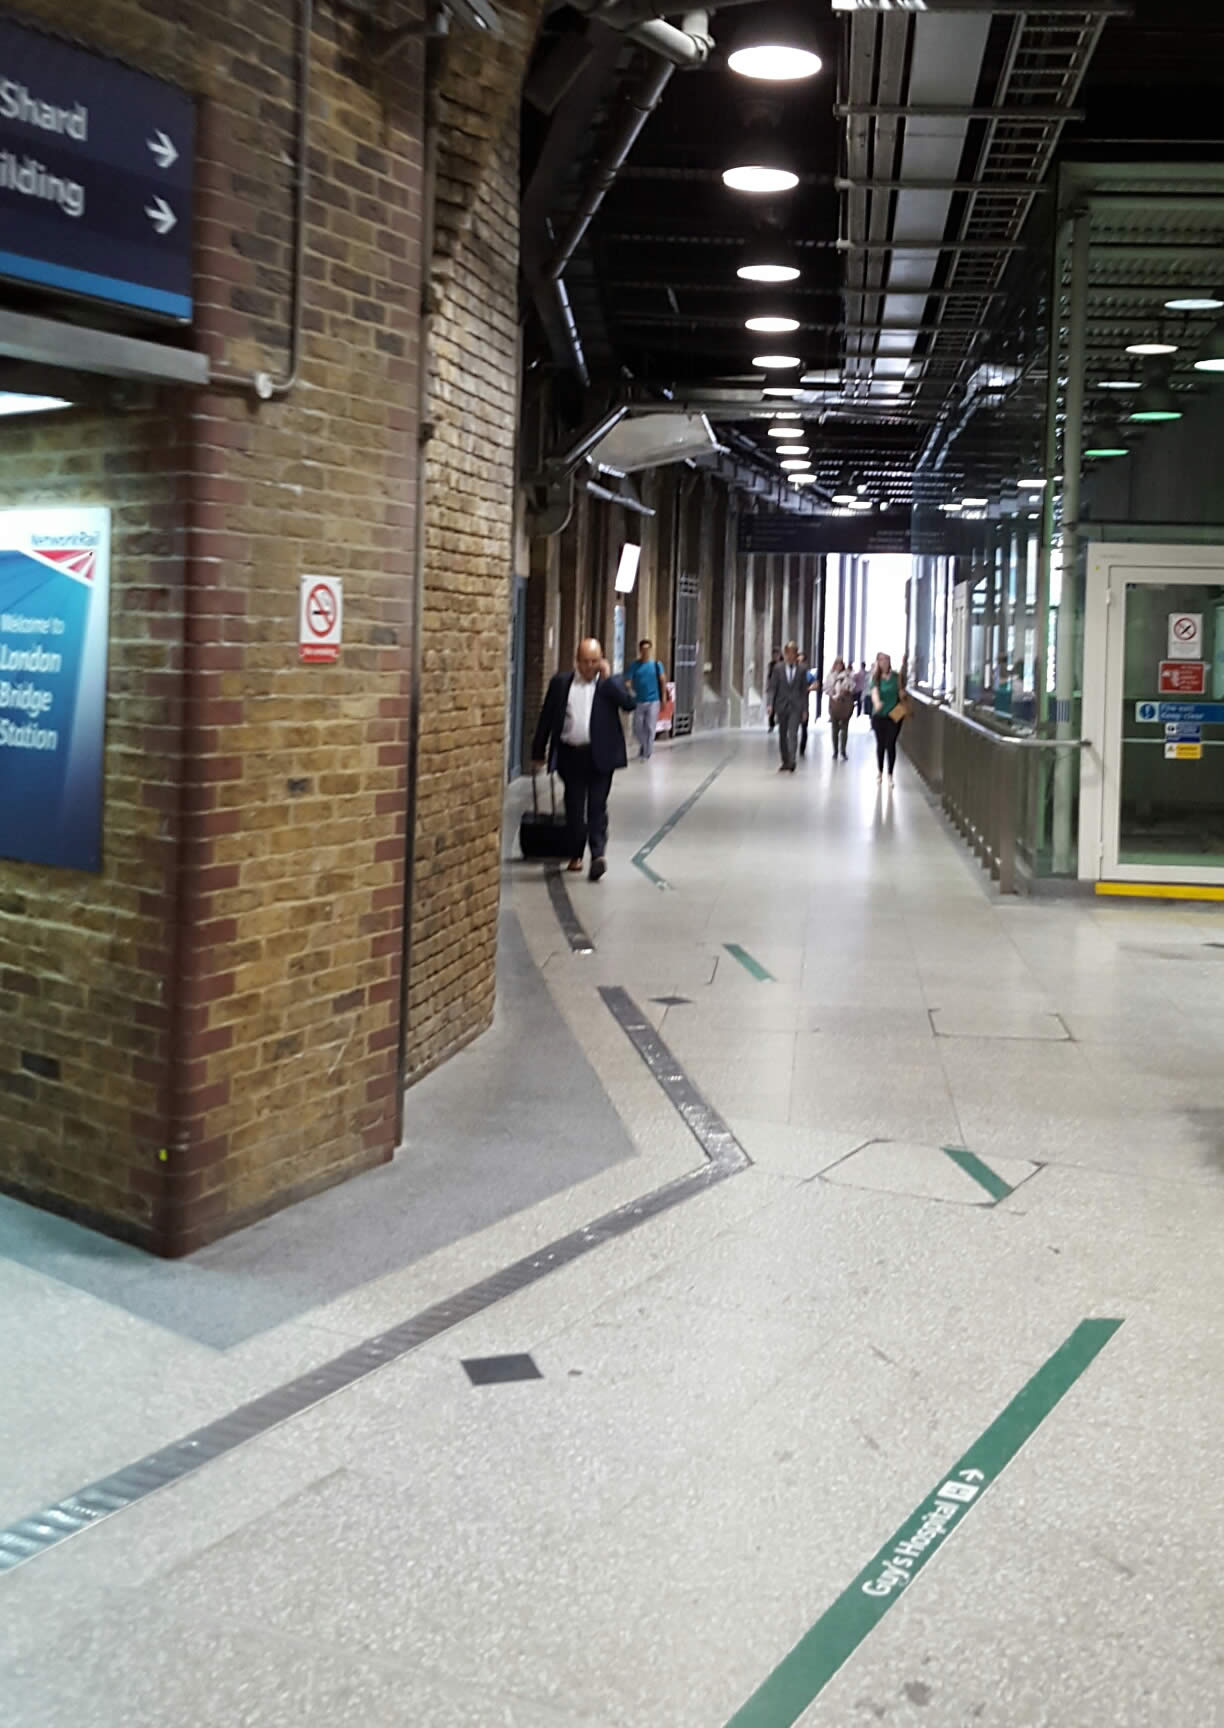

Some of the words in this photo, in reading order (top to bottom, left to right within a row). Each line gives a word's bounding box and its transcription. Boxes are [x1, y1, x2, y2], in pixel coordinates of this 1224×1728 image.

[0, 78, 88, 141] Shard
[1, 613, 49, 633] Welcome
[49, 616, 65, 634] to
[0, 643, 62, 672] London
[0, 680, 53, 718] Bridge
[0, 718, 58, 750] Station
[893, 1500, 960, 1558] Hospital
